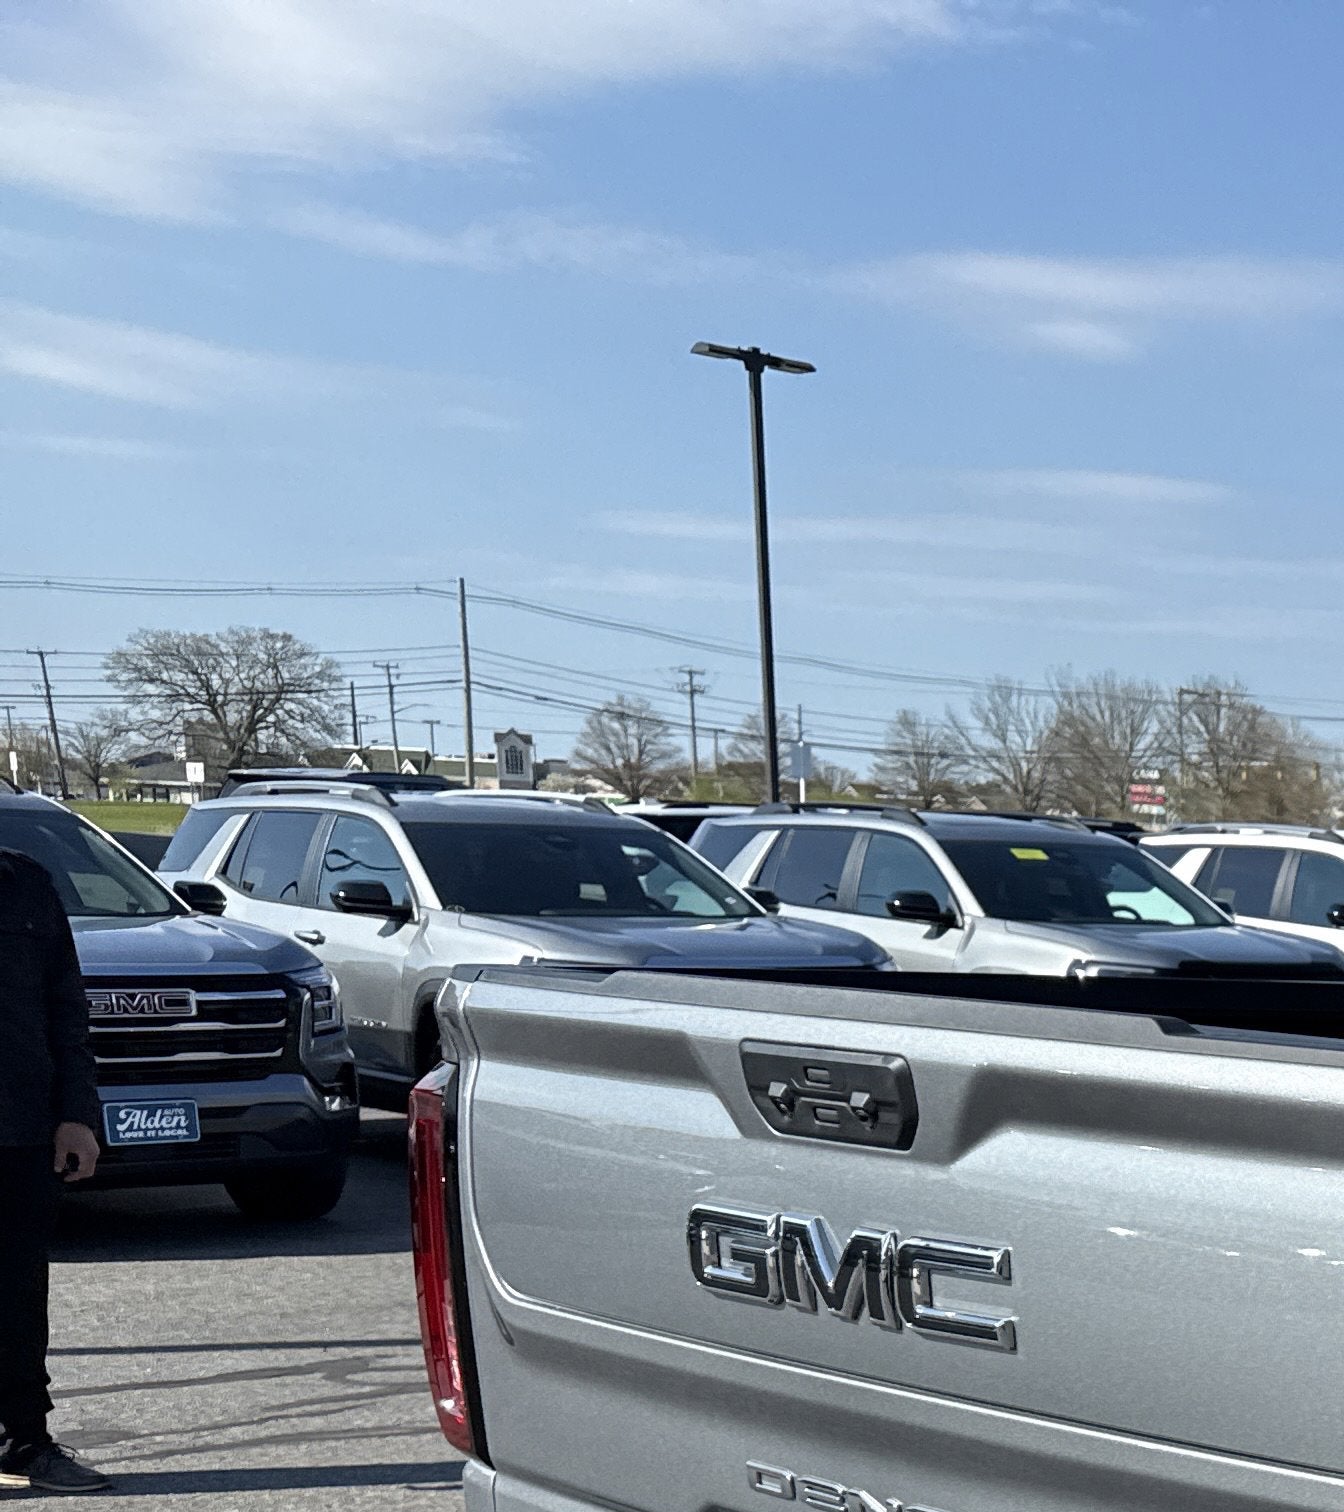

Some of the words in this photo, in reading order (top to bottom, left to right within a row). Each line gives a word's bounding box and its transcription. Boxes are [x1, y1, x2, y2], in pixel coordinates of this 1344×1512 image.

[85, 993, 191, 1014] GMC
[116, 1107, 189, 1132] Alden
[162, 1107, 186, 1116] AUTO
[686, 1202, 1018, 1354] GMC
